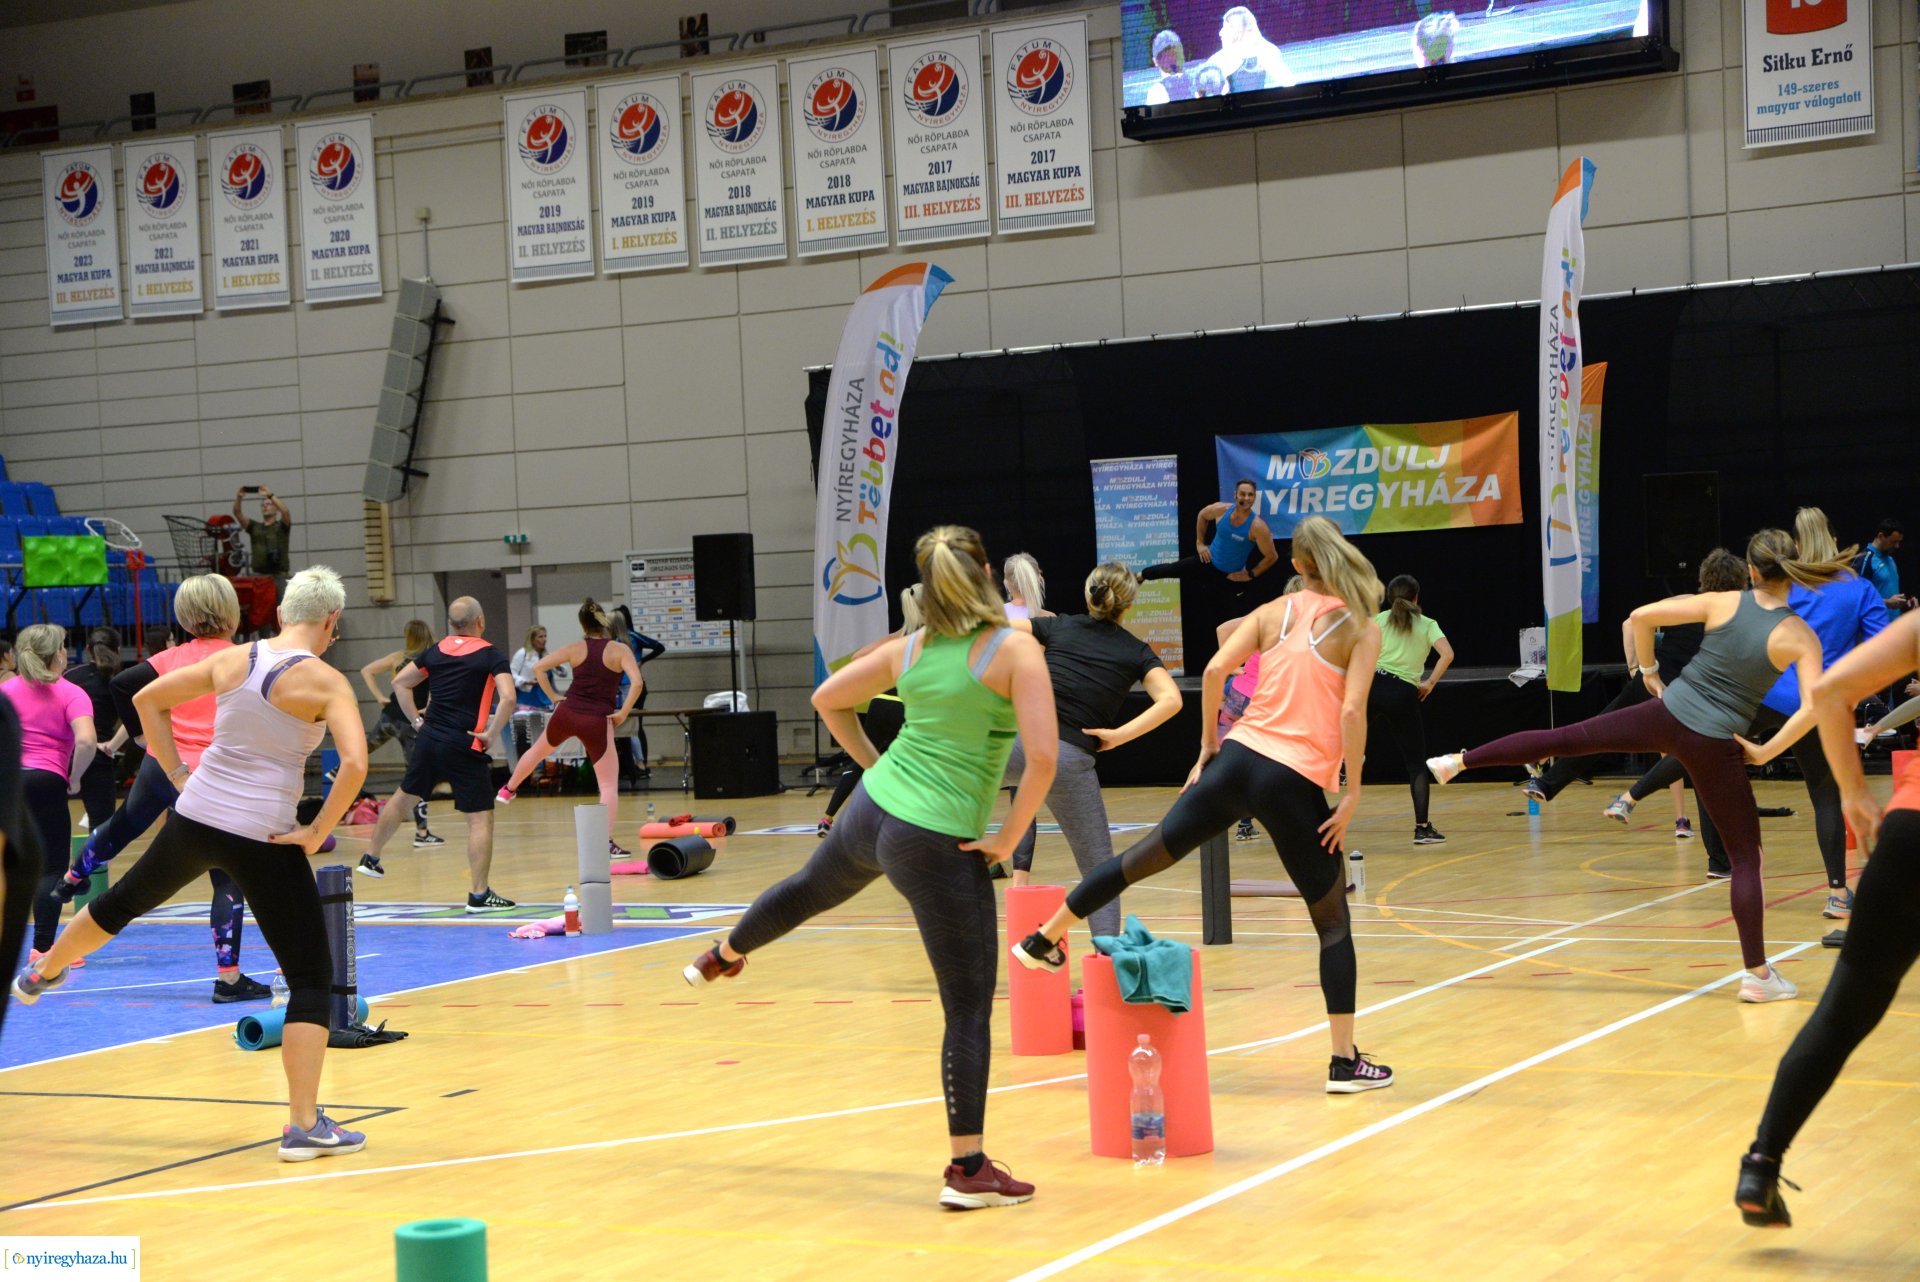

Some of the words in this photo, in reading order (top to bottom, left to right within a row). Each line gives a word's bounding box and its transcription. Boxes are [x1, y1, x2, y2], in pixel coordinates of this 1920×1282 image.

[1011, 41, 1052, 70] FATUM
[1763, 53, 1806, 73] Sitku
[1811, 43, 1853, 66] Ernő
[908, 54, 947, 83] FATUM
[807, 71, 845, 99] FATUM
[1778, 80, 1840, 96] 149-szeres
[710, 82, 746, 111] FATUM
[1757, 100, 1800, 116] magyar
[1804, 91, 1861, 108] válogatott
[614, 96, 649, 123] FATUM
[523, 107, 557, 133] FATUM
[1023, 131, 1061, 143] CSAPATA
[313, 136, 344, 161] FATUM
[921, 142, 957, 154] CSAPATA
[1031, 149, 1056, 164] 2017
[224, 146, 255, 170] FATUM
[820, 157, 856, 168] CSAPATA
[66, 161, 90, 174] FATUM
[139, 156, 170, 180] FATUM
[721, 168, 756, 178] CSAPATA
[928, 160, 952, 175] 2017
[1008, 169, 1050, 184] MAGYAR
[1053, 166, 1081, 179] KUPA
[625, 179, 659, 189] CSAPATA
[828, 175, 851, 189] 2018
[903, 183, 935, 196] MAGYAR
[937, 172, 979, 193] BAJNOKSÁG
[533, 189, 565, 199] CSAPATA
[728, 185, 751, 199] 2018
[806, 194, 846, 209] MAGYAR
[849, 190, 875, 203] KUPA
[1006, 195, 1022, 208] III.
[1025, 184, 1084, 207] HELYEZÉS
[539, 205, 561, 218] 2019
[632, 196, 654, 209] 2019
[705, 206, 734, 218] MAGYAR
[736, 197, 776, 215] BAJNOKSÁG
[905, 205, 920, 219] III.
[924, 193, 981, 216] HELYEZÉS
[234, 224, 264, 232] CSAPATA
[324, 215, 354, 224] CSAPATA
[518, 224, 545, 236] MAGYAR
[547, 217, 584, 234] BAJNOKSÁG
[612, 214, 649, 228] MAGYAR
[651, 211, 676, 223] KUPA
[807, 219, 815, 232] I.
[818, 207, 876, 230] HELYEZÉS
[149, 232, 177, 241] CSAPATA
[330, 230, 350, 242] 2020
[612, 238, 619, 250] I.
[622, 227, 678, 248] HELYEZÉS
[706, 228, 717, 241] II.
[720, 218, 777, 239] HELYEZÉS
[68, 241, 96, 249] CSAPATA
[155, 248, 173, 259] 2021
[240, 239, 259, 251] 2021
[312, 247, 346, 260] MAGYAR
[347, 244, 370, 256] KUPA
[519, 245, 529, 258] II.
[532, 236, 585, 256] HELYEZÉS
[74, 255, 92, 266] 2023
[135, 263, 160, 274] MAGYAR
[161, 260, 195, 273] BAJNOKSÁG
[222, 255, 256, 268] MAGYAR
[257, 254, 279, 264] KUPA
[57, 270, 89, 283] MAGYAR
[91, 269, 111, 280] KUPA
[224, 277, 229, 288] I.
[232, 269, 280, 286] HELYEZÉS
[311, 269, 320, 281] II.
[324, 261, 373, 280] HELYEZÉS
[56, 292, 68, 304] III.
[71, 284, 115, 302] HELYEZÉS
[138, 285, 144, 296] I.
[147, 278, 193, 295] HELYEZÉS
[858, 400, 895, 524] Többet
[877, 331, 904, 396] ad!
[834, 377, 865, 522] NYÍREGYHÁZA
